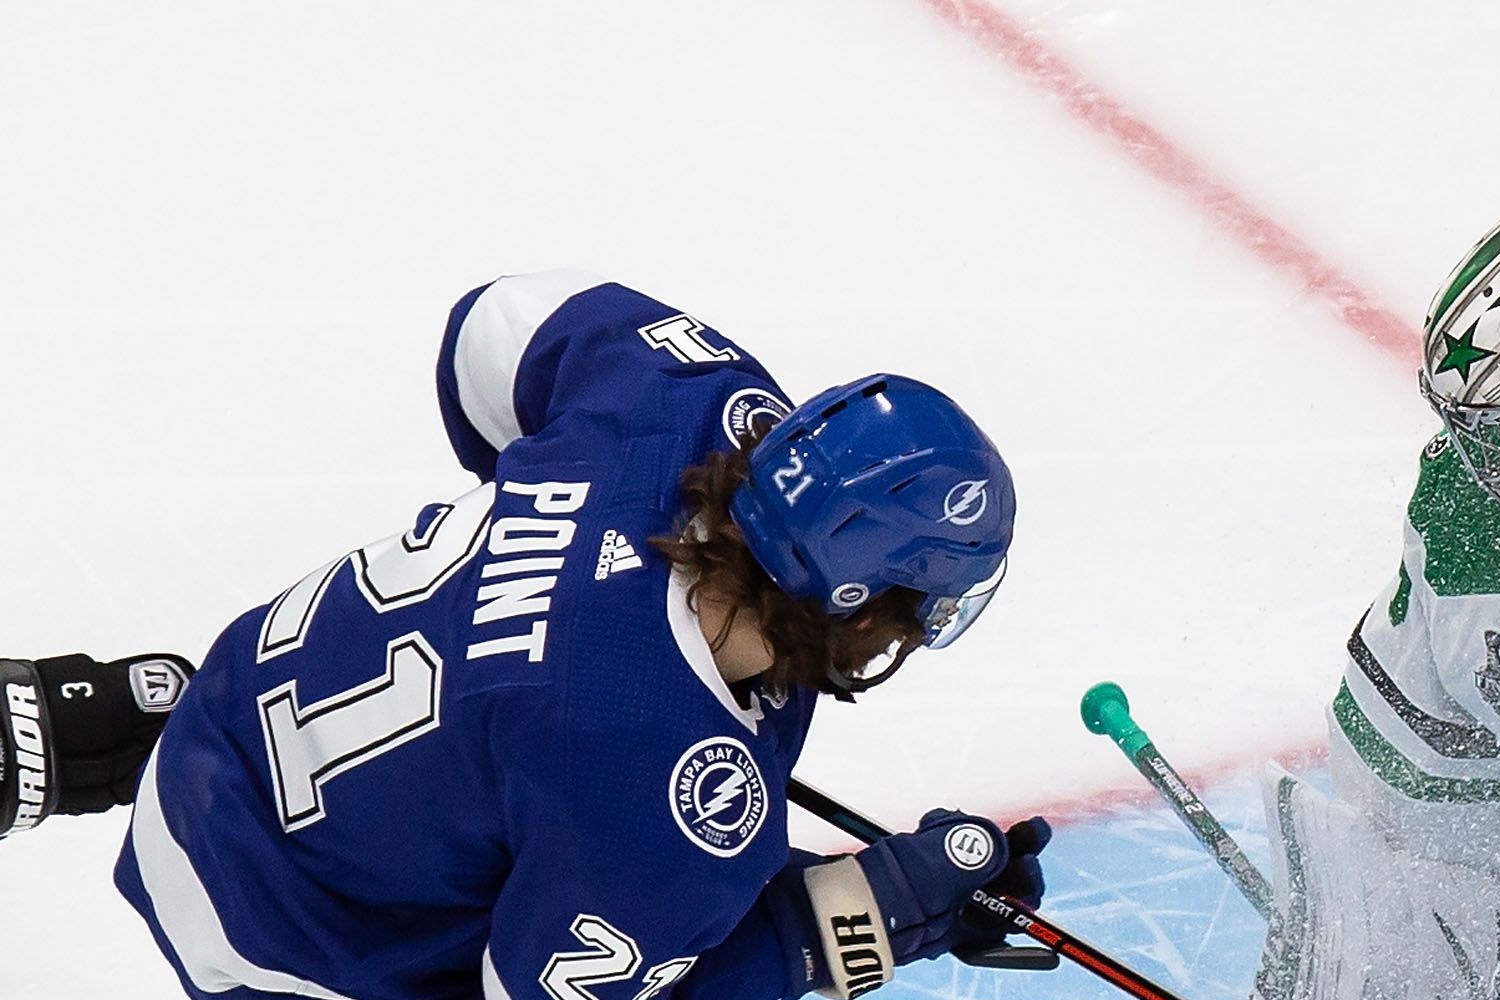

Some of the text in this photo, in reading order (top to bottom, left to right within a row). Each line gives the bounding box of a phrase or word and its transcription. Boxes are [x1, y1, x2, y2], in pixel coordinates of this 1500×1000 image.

[636, 313, 741, 363] 1
[772, 454, 815, 507] 21
[465, 481, 591, 663] POINT
[595, 529, 617, 580] adidas
[257, 481, 496, 833] 21
[61, 682, 94, 699] 3
[6, 682, 46, 830] RRIOR
[679, 747, 762, 838] TAMPA BAY LIGHTNING
[1185, 802, 1204, 814] 2
